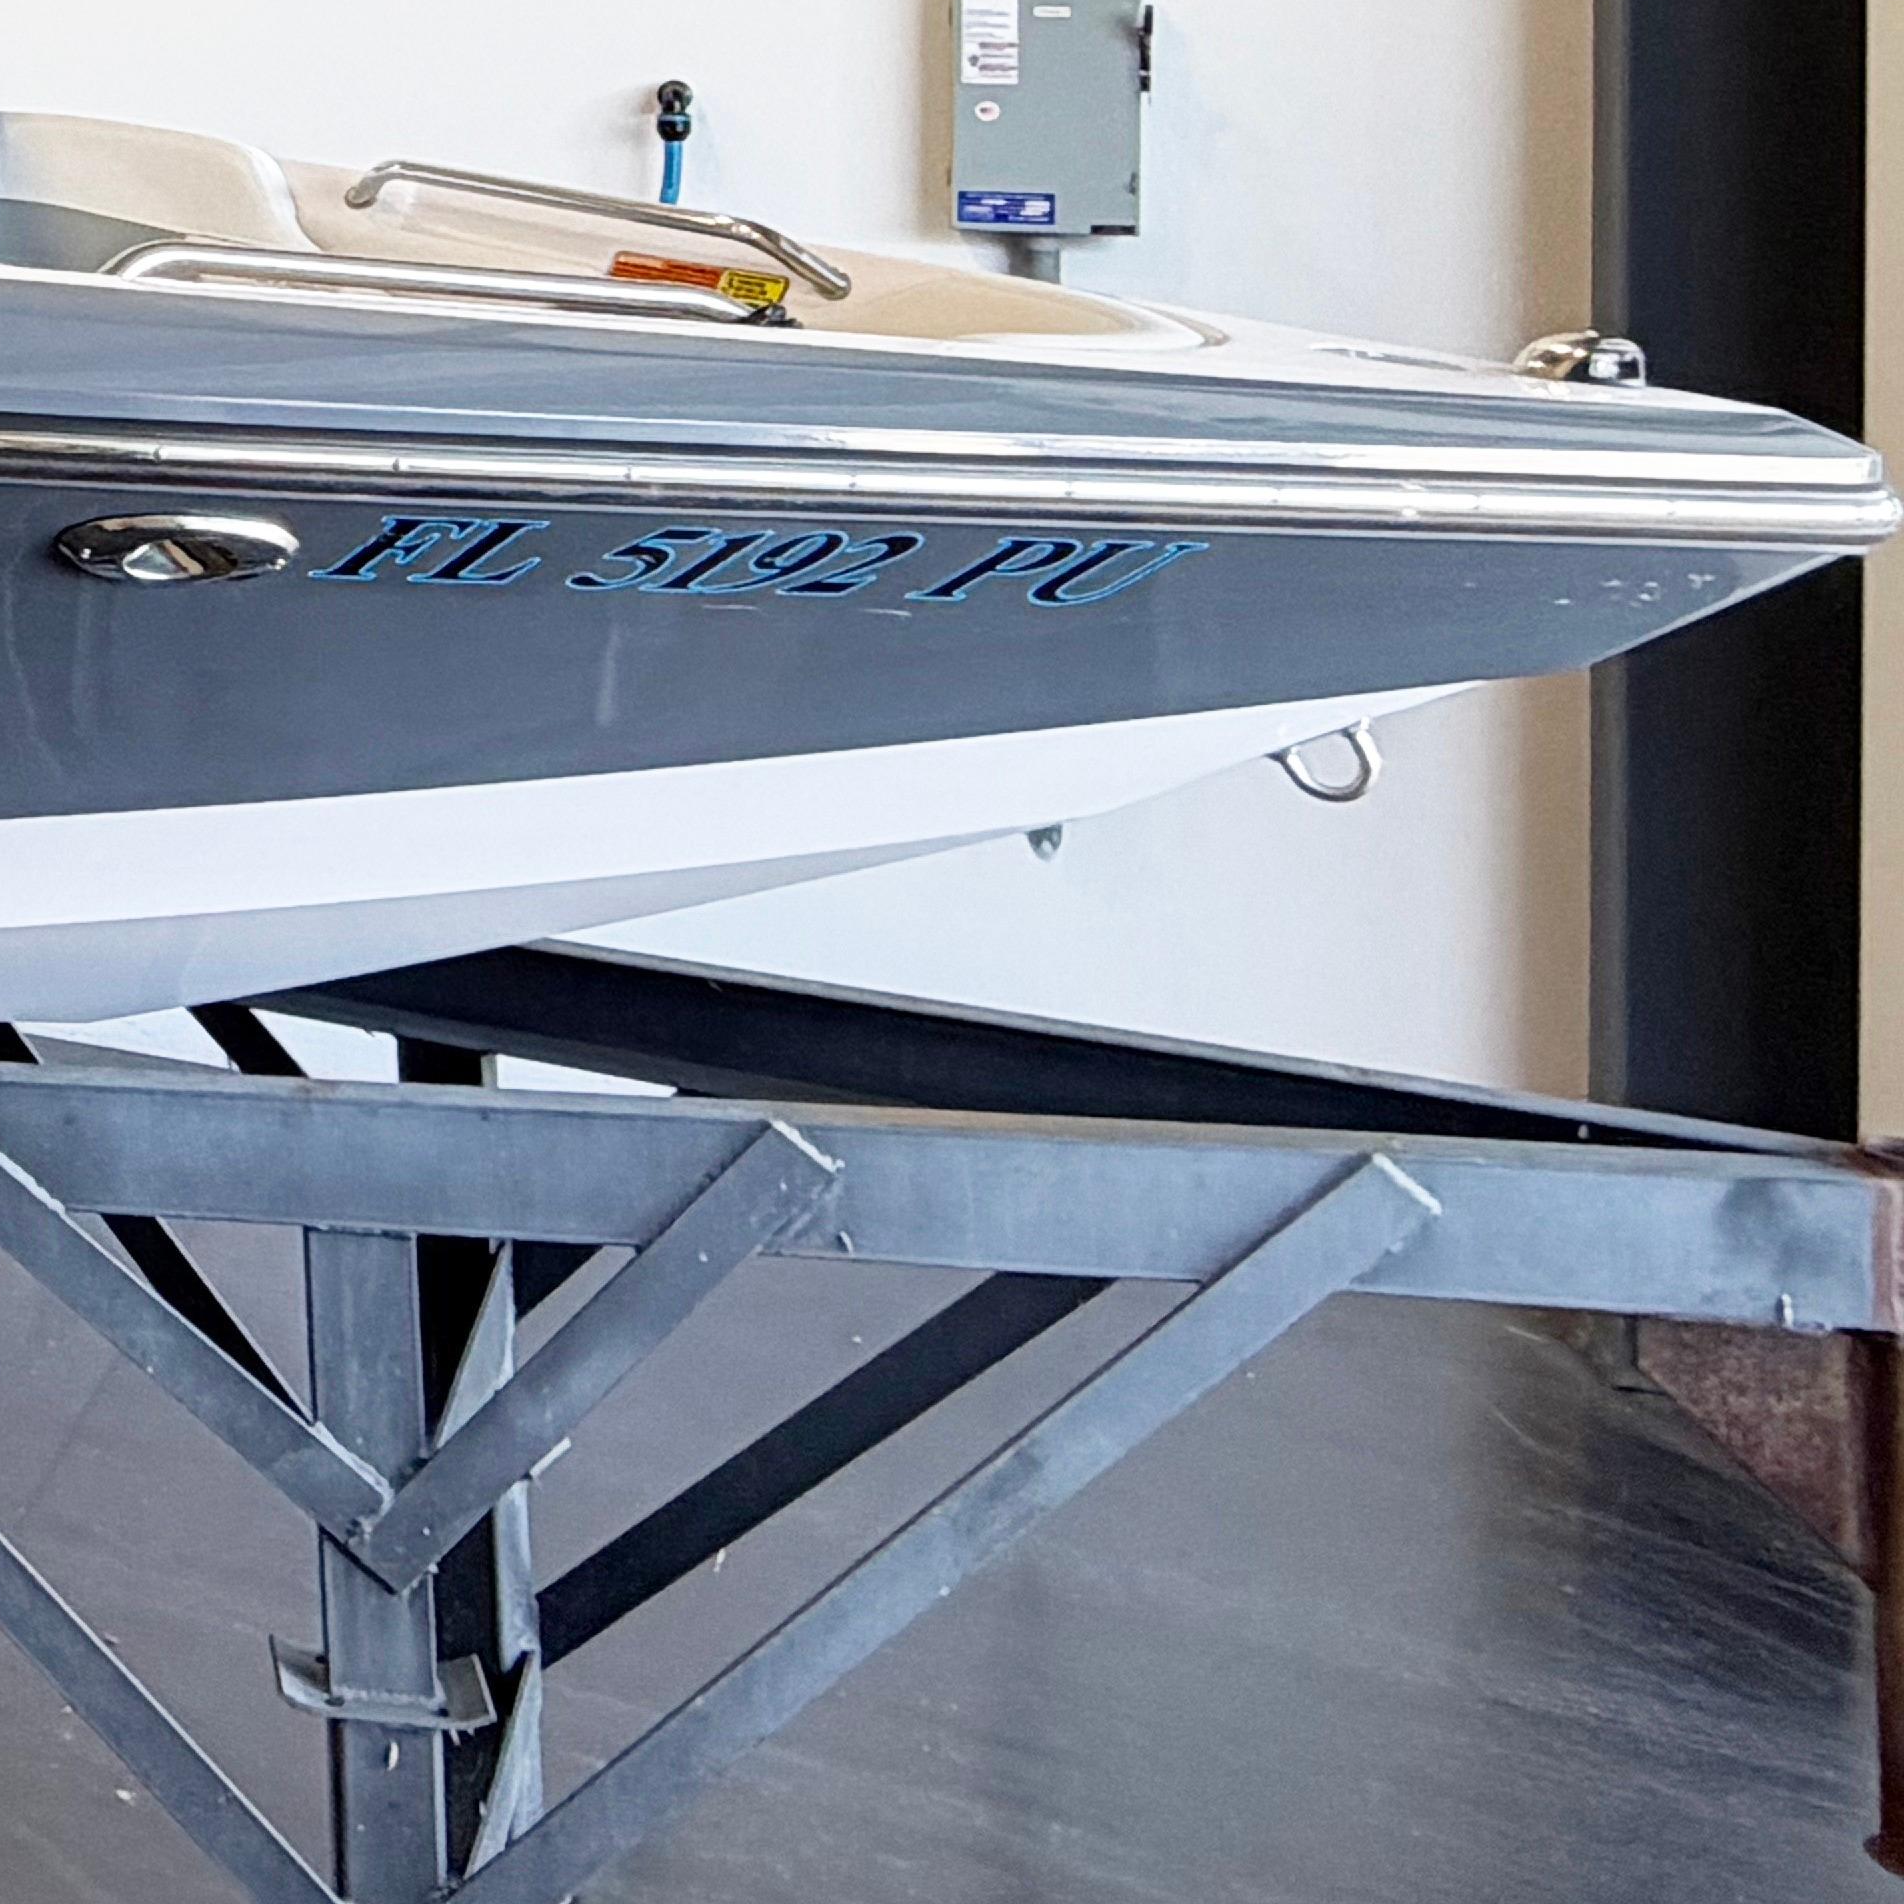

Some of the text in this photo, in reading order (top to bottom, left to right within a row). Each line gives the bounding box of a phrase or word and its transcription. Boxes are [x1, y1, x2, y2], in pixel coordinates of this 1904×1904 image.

[307, 515, 1210, 611] FL 5192 PU
